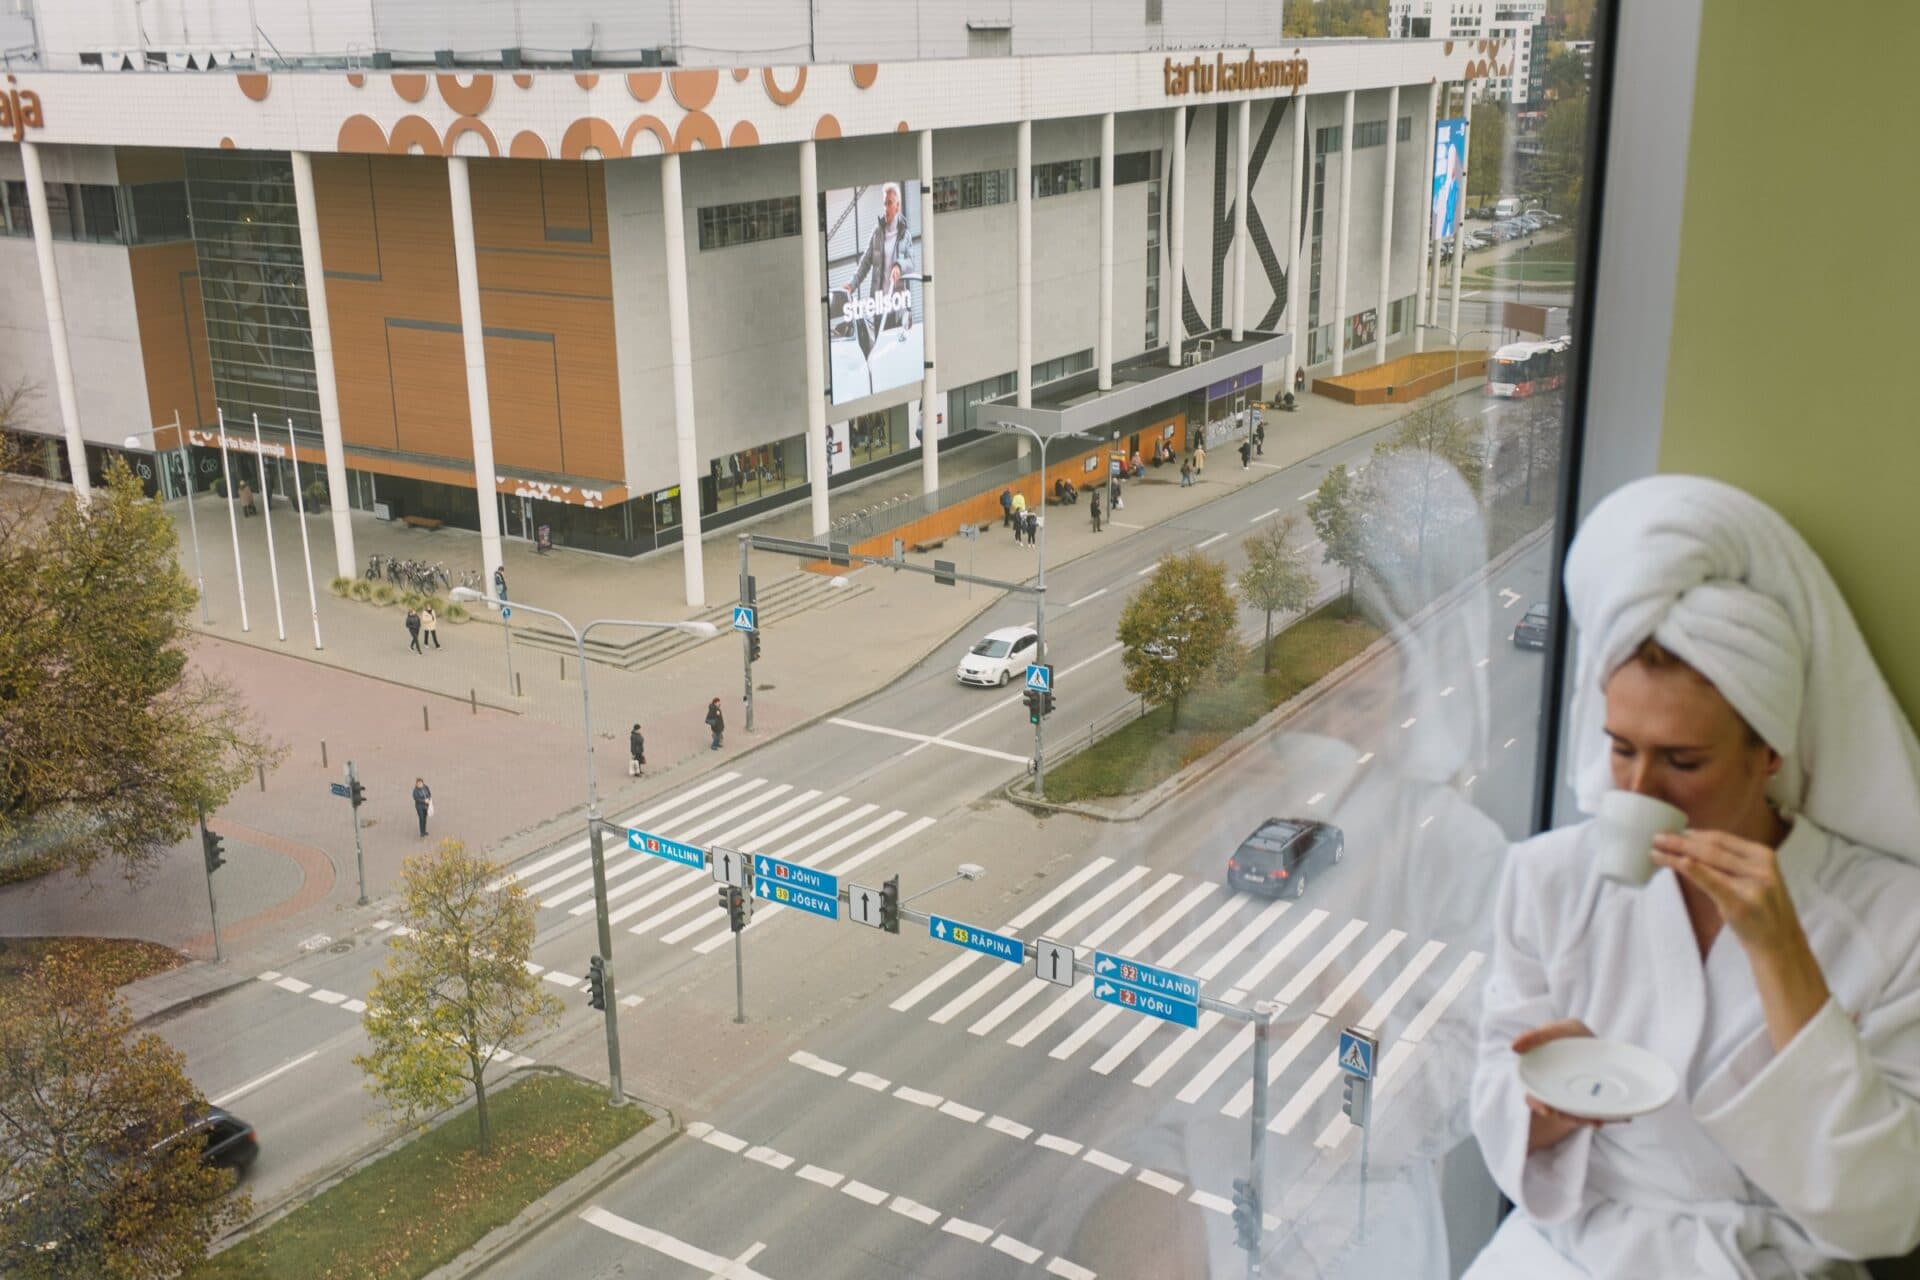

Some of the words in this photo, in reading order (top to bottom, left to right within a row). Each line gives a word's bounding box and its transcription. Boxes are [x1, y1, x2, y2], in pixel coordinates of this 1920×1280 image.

[1163, 56, 1214, 96] tartu
[1216, 48, 1309, 97] kaubamaja
[843, 290, 912, 322] strellson
[661, 843, 699, 863] TALLINN
[791, 870, 820, 887] JÕHVI
[791, 892, 831, 913] JÕGEVA
[954, 929, 968, 942] 45
[971, 934, 1012, 955] RÄPINA
[1122, 966, 1136, 981] 92
[1140, 971, 1196, 997] VILJANDI
[1139, 996, 1173, 1015] VÕRU
